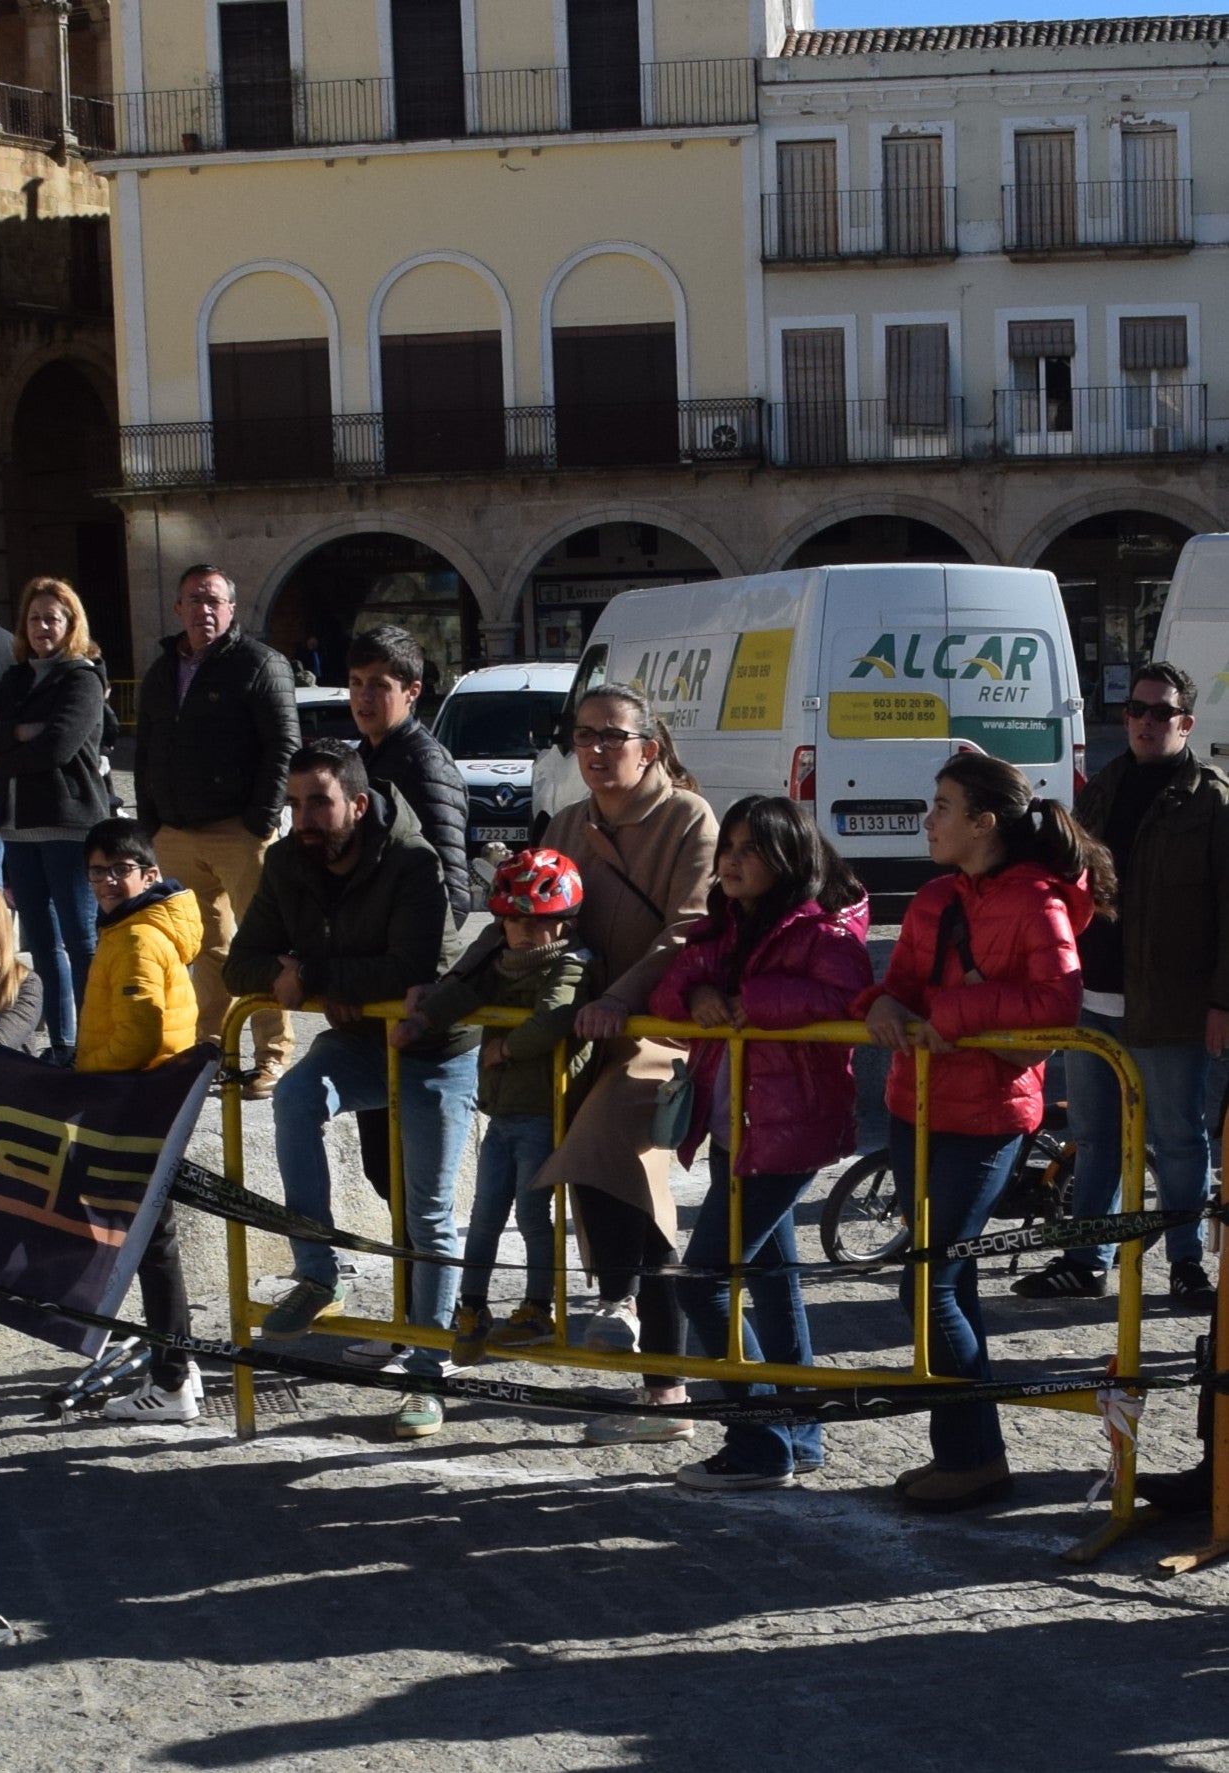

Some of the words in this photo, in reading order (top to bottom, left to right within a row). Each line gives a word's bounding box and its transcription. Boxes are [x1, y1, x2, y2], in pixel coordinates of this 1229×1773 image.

[849, 633, 1039, 681] ALCAR
[630, 648, 712, 701] ALCAR
[978, 686, 1030, 703] RENT
[873, 698, 891, 708] 603
[894, 698, 907, 708] 80
[909, 698, 921, 708] 20
[923, 698, 936, 708] 90
[874, 711, 892, 721] 924
[895, 711, 914, 721] 308
[918, 711, 936, 721] 850
[982, 720, 1047, 730] www.alcar.info
[849, 816, 885, 831] 8133
[889, 815, 915, 830] LRY
[479, 828, 509, 840] 7222
[512, 828, 527, 840] JB
[946, 1228, 1043, 1260] #DEPORTE
[444, 1377, 533, 1401] #DEPORTE
